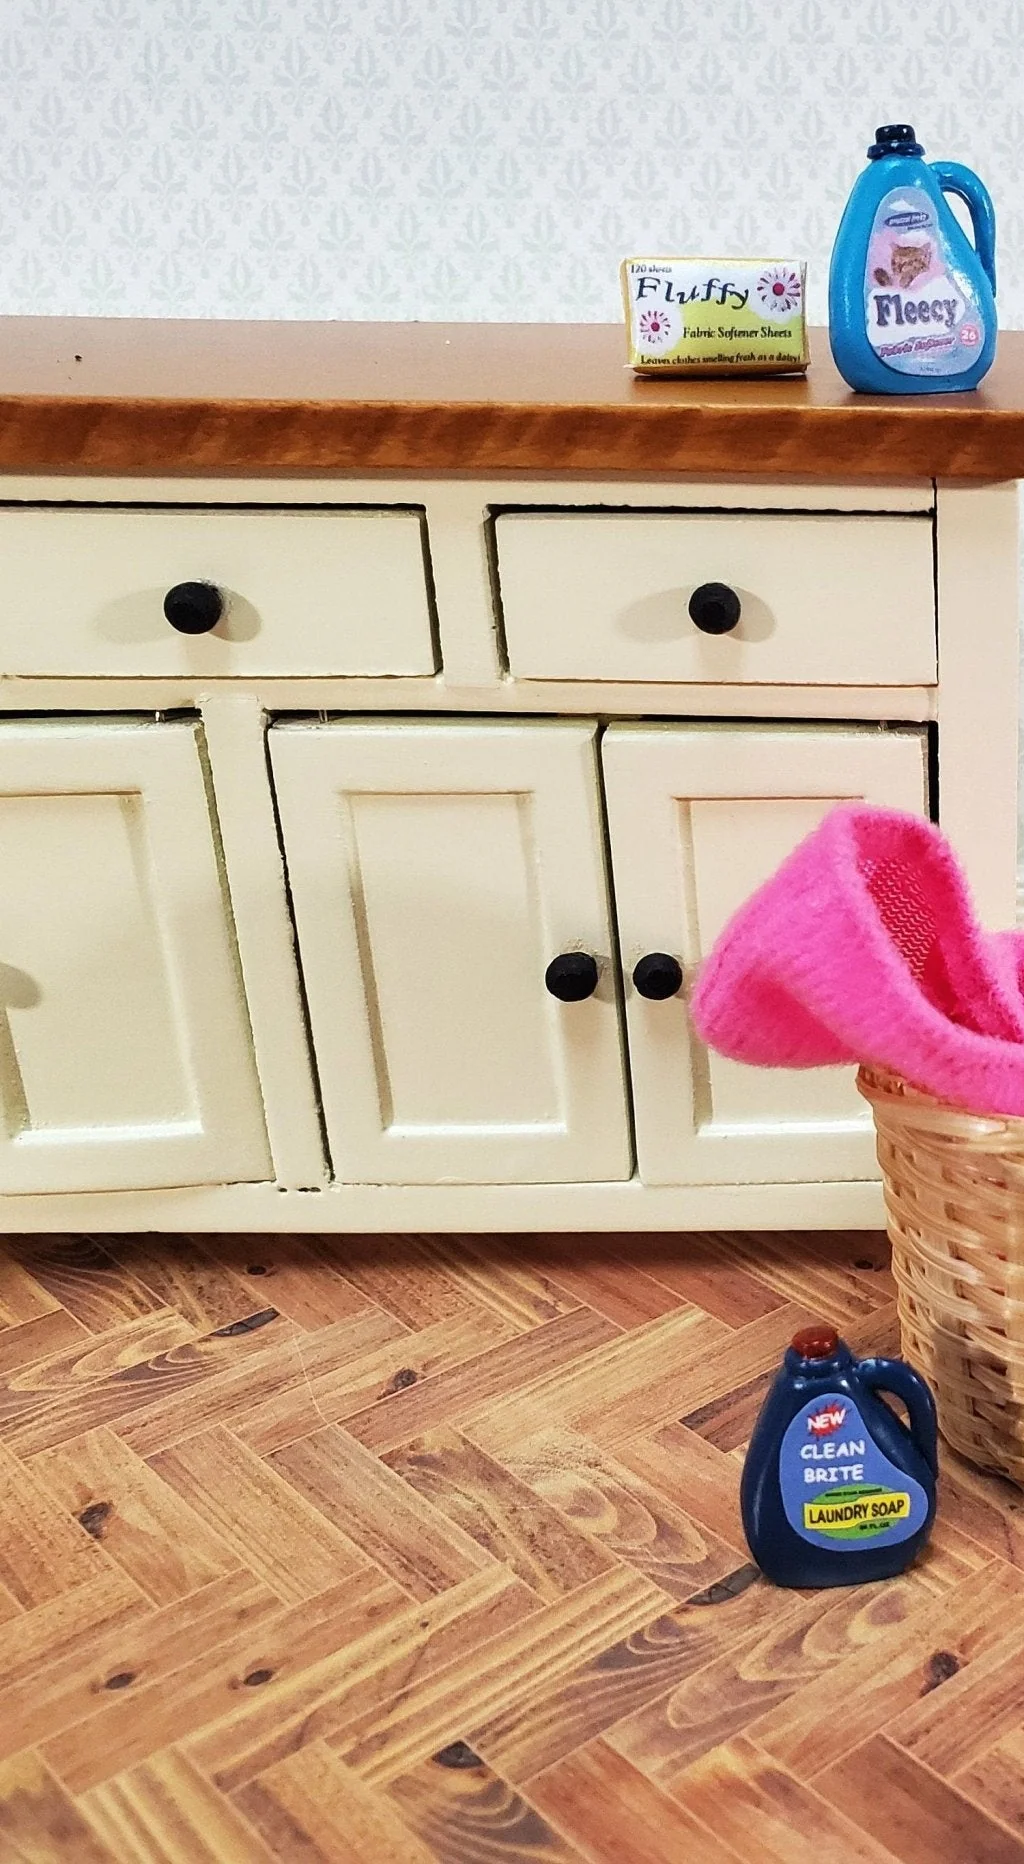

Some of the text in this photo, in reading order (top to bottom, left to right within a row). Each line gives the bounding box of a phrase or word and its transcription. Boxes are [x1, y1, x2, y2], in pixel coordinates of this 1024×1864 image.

[631, 264, 647, 273] 120
[636, 276, 749, 310] Fluffy
[873, 295, 957, 327] Fleecy
[683, 325, 792, 340] Fabric Softener Sheets
[960, 329, 977, 341] 26
[641, 355, 670, 364] Leaves
[807, 1408, 846, 1430] NEW
[801, 1440, 865, 1459] CLEAN
[804, 1464, 864, 1483] BRITE
[809, 1499, 905, 1523] LAUNDRY SOAP
